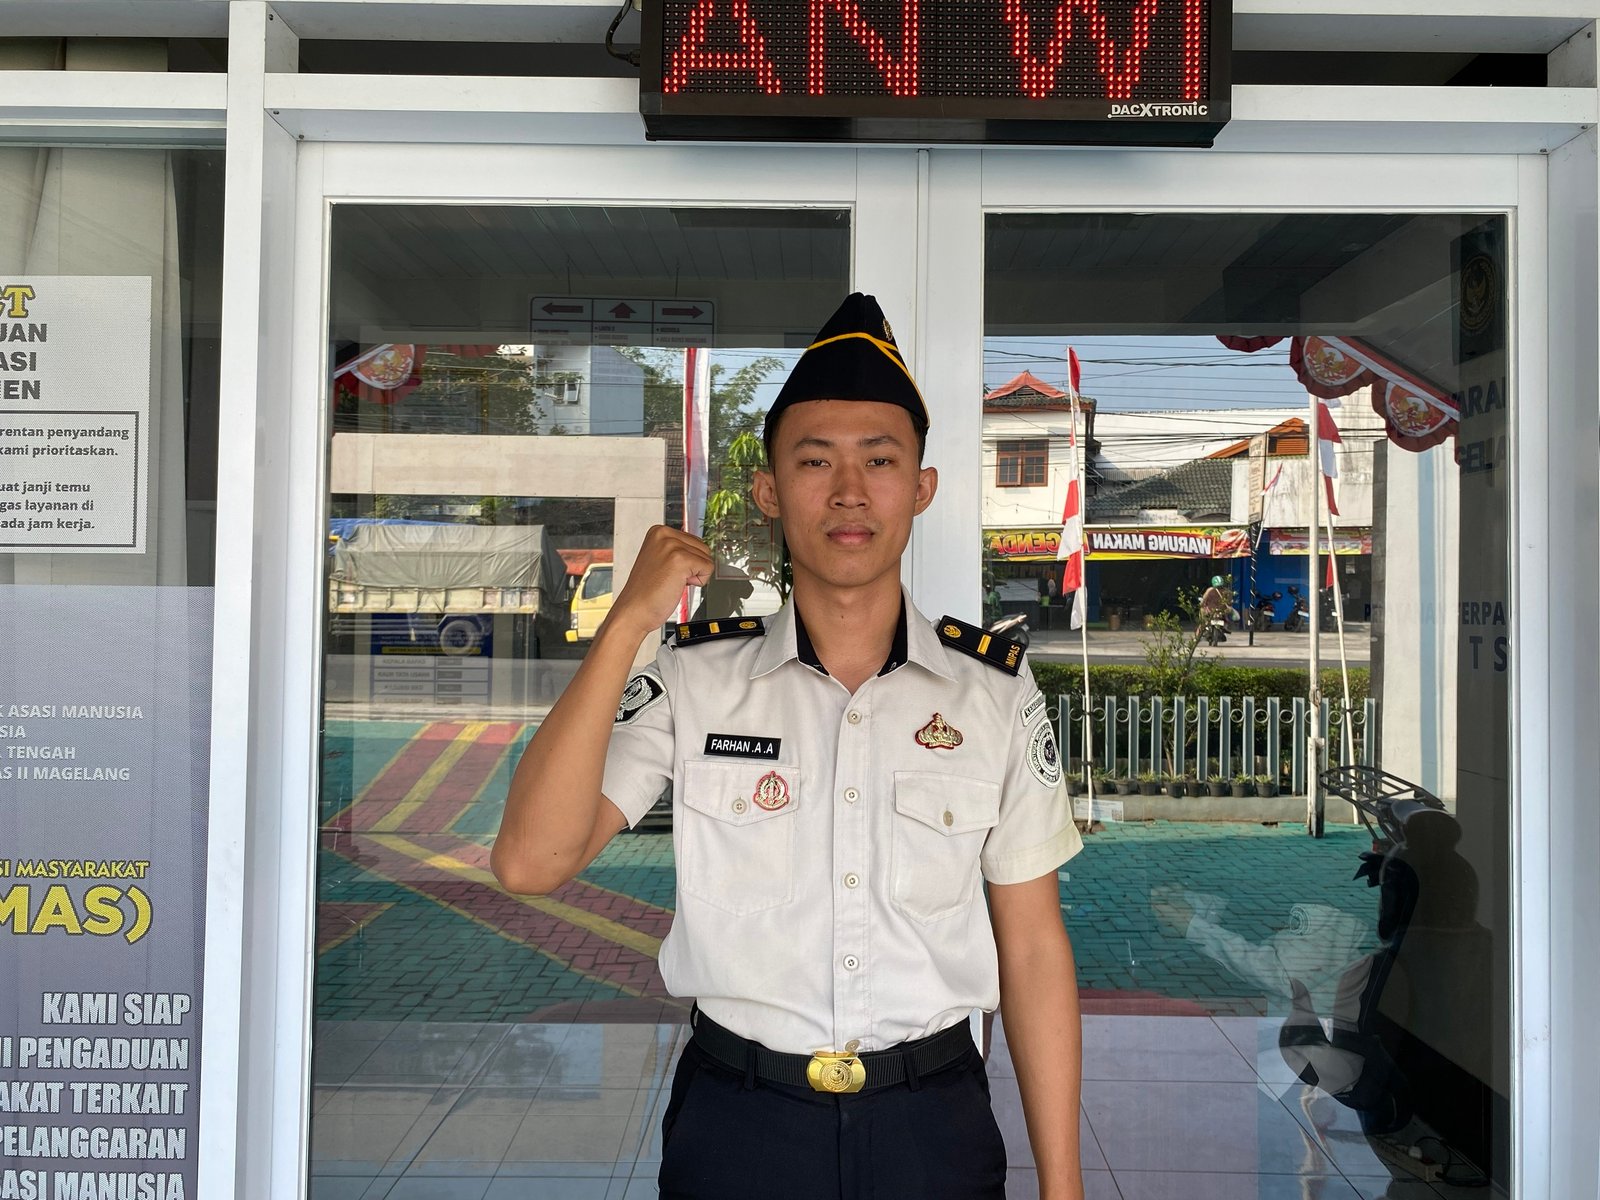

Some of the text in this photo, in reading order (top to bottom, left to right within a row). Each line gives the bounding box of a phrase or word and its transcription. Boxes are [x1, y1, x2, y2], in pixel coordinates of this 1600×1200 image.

[663, 0, 919, 96] AN
[0, 427, 130, 440] rentan penyandang
[32, 445, 119, 458] prioritaskan.
[21, 481, 52, 495] janji
[55, 482, 91, 492] temu
[0, 499, 94, 513] gas layanan di
[27, 518, 53, 531] jam
[56, 518, 95, 532] kerja.
[8, 704, 57, 718] ASASI
[61, 705, 144, 720] MANUSIA
[0, 725, 26, 739] SIA
[6, 745, 76, 760] TENGAH
[710, 738, 751, 753] FARHAN
[0, 766, 131, 781] S II MAGELANG
[16, 859, 150, 879] MASYARAKAT
[42, 991, 192, 1026] KAMI SIAP
[18, 1036, 190, 1070] PENGADUAN
[69, 1082, 189, 1115] TERKAIT
[0, 1125, 187, 1160] ELANGGARAN
[53, 1171, 186, 1200] MANUSIA
